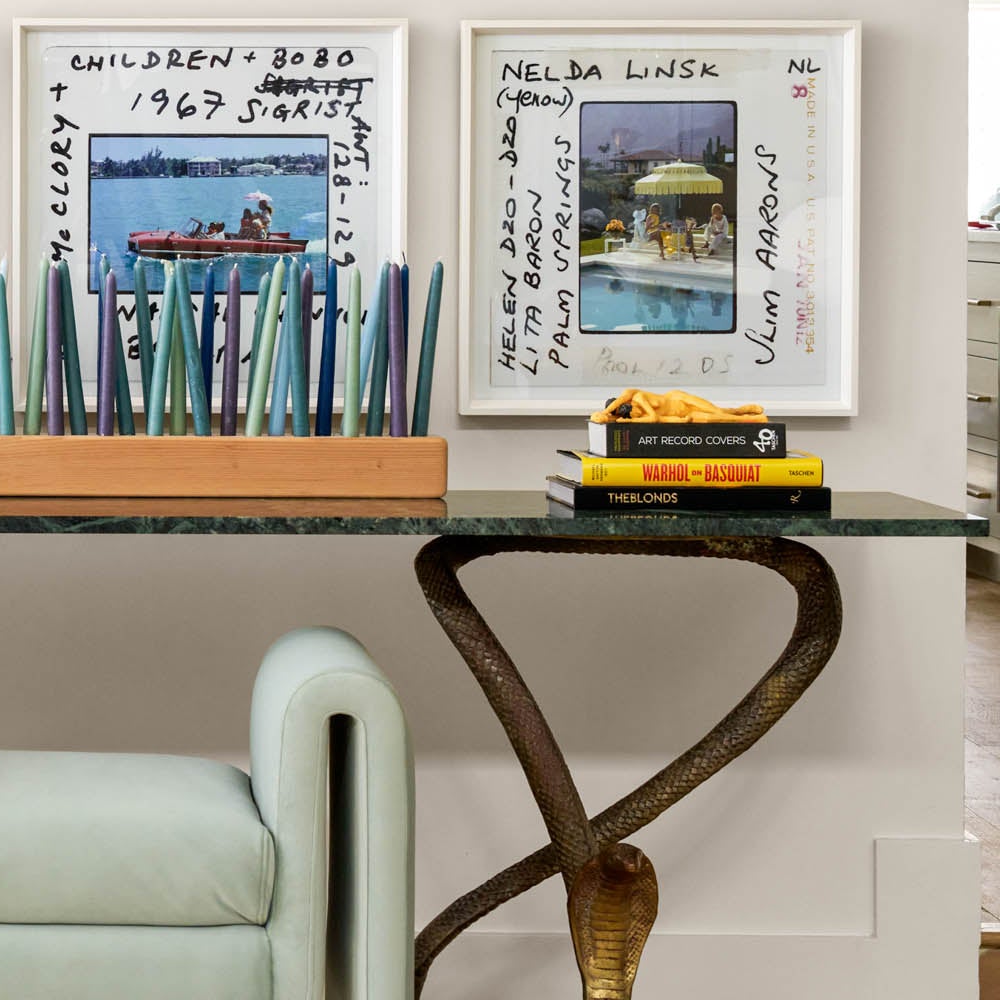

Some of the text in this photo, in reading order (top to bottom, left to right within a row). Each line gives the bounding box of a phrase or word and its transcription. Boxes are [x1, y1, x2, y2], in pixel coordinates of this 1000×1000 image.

[70, 47, 233, 72] CHILDREN
[271, 48, 354, 67] BOBO
[500, 59, 719, 82] NELDA LINSK
[787, 58, 821, 75] NL
[791, 84, 808, 99] 8
[804, 77, 817, 120] MADE
[130, 88, 362, 124] 1967 SIGRIST
[804, 125, 817, 139] IN
[549, 135, 576, 368] PALM SPRINGS
[744, 144, 781, 365] SLIM AARONS
[520, 190, 542, 375] LITA BARON
[497, 270, 519, 371] HELEN
[638, 436, 746, 446] ART RECORD COVERS
[642, 464, 690, 482] WARHOL
[704, 464, 761, 483] BASQUIAT
